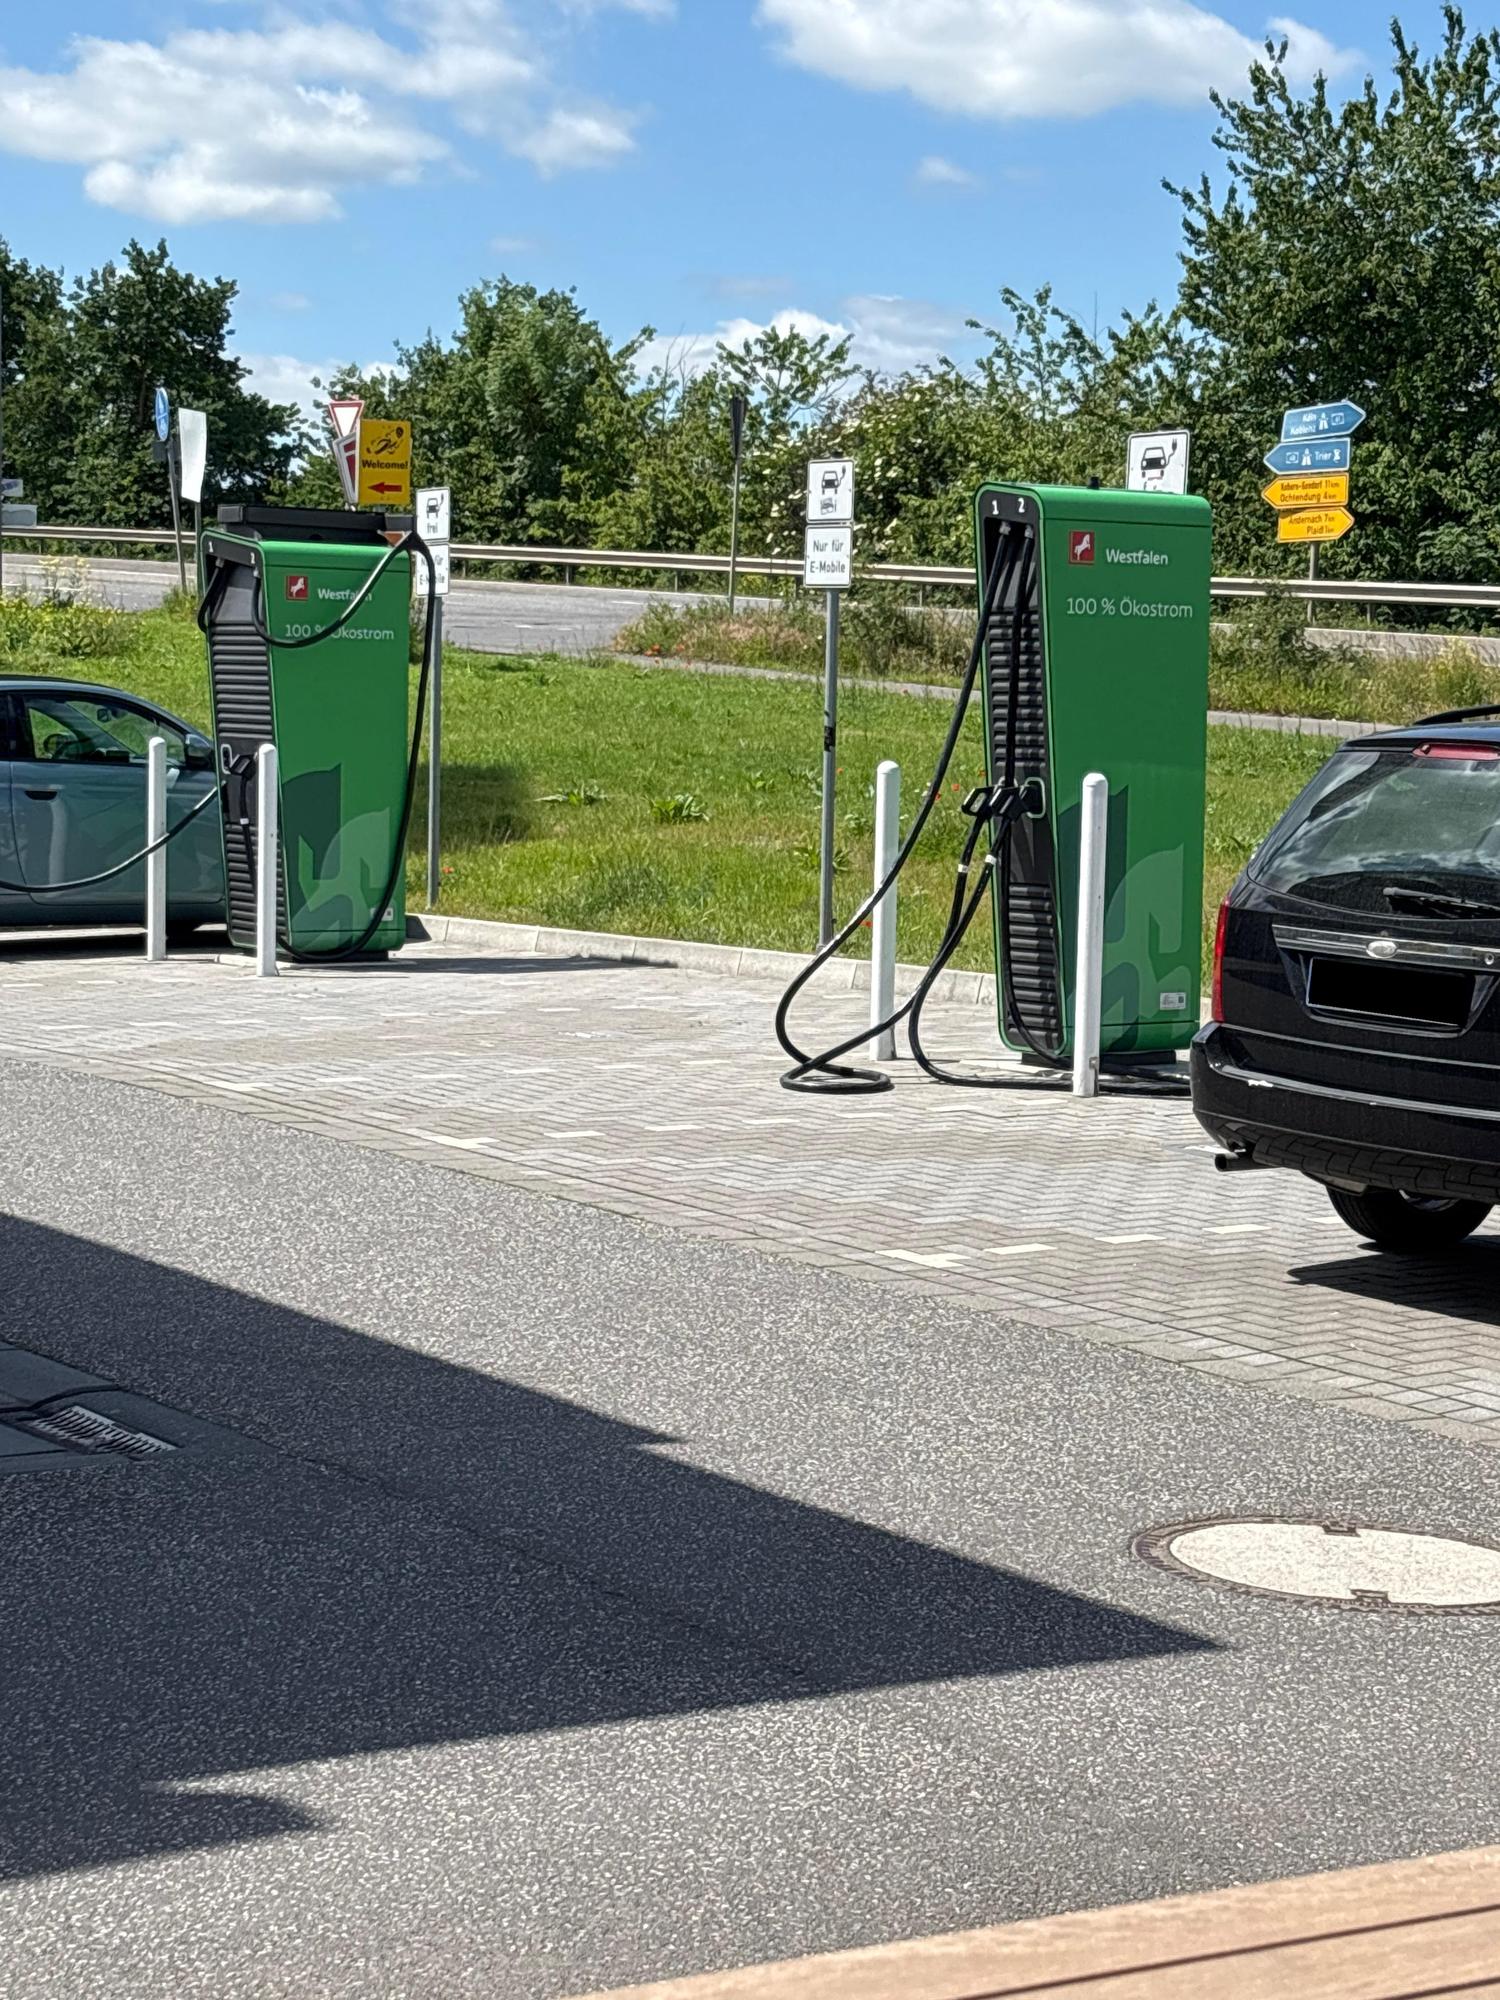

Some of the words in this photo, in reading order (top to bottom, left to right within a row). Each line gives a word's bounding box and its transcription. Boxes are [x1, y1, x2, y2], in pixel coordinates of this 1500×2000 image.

[1315, 450, 1332, 461] Trier
[362, 459, 408, 470] Welcome!
[991, 500, 999, 515] 1
[1017, 498, 1026, 513] 2
[427, 523, 438, 534] frei
[813, 540, 828, 552] Nur
[831, 539, 844, 552] für
[208, 541, 214, 553] 1
[250, 552, 256, 564] 2
[1105, 548, 1169, 565] Westfalen
[810, 561, 845, 573] E-Mobile
[1066, 598, 1097, 615] 100
[1101, 598, 1116, 615] %
[1120, 596, 1193, 617] Ökostrom
[285, 624, 311, 637] 100
